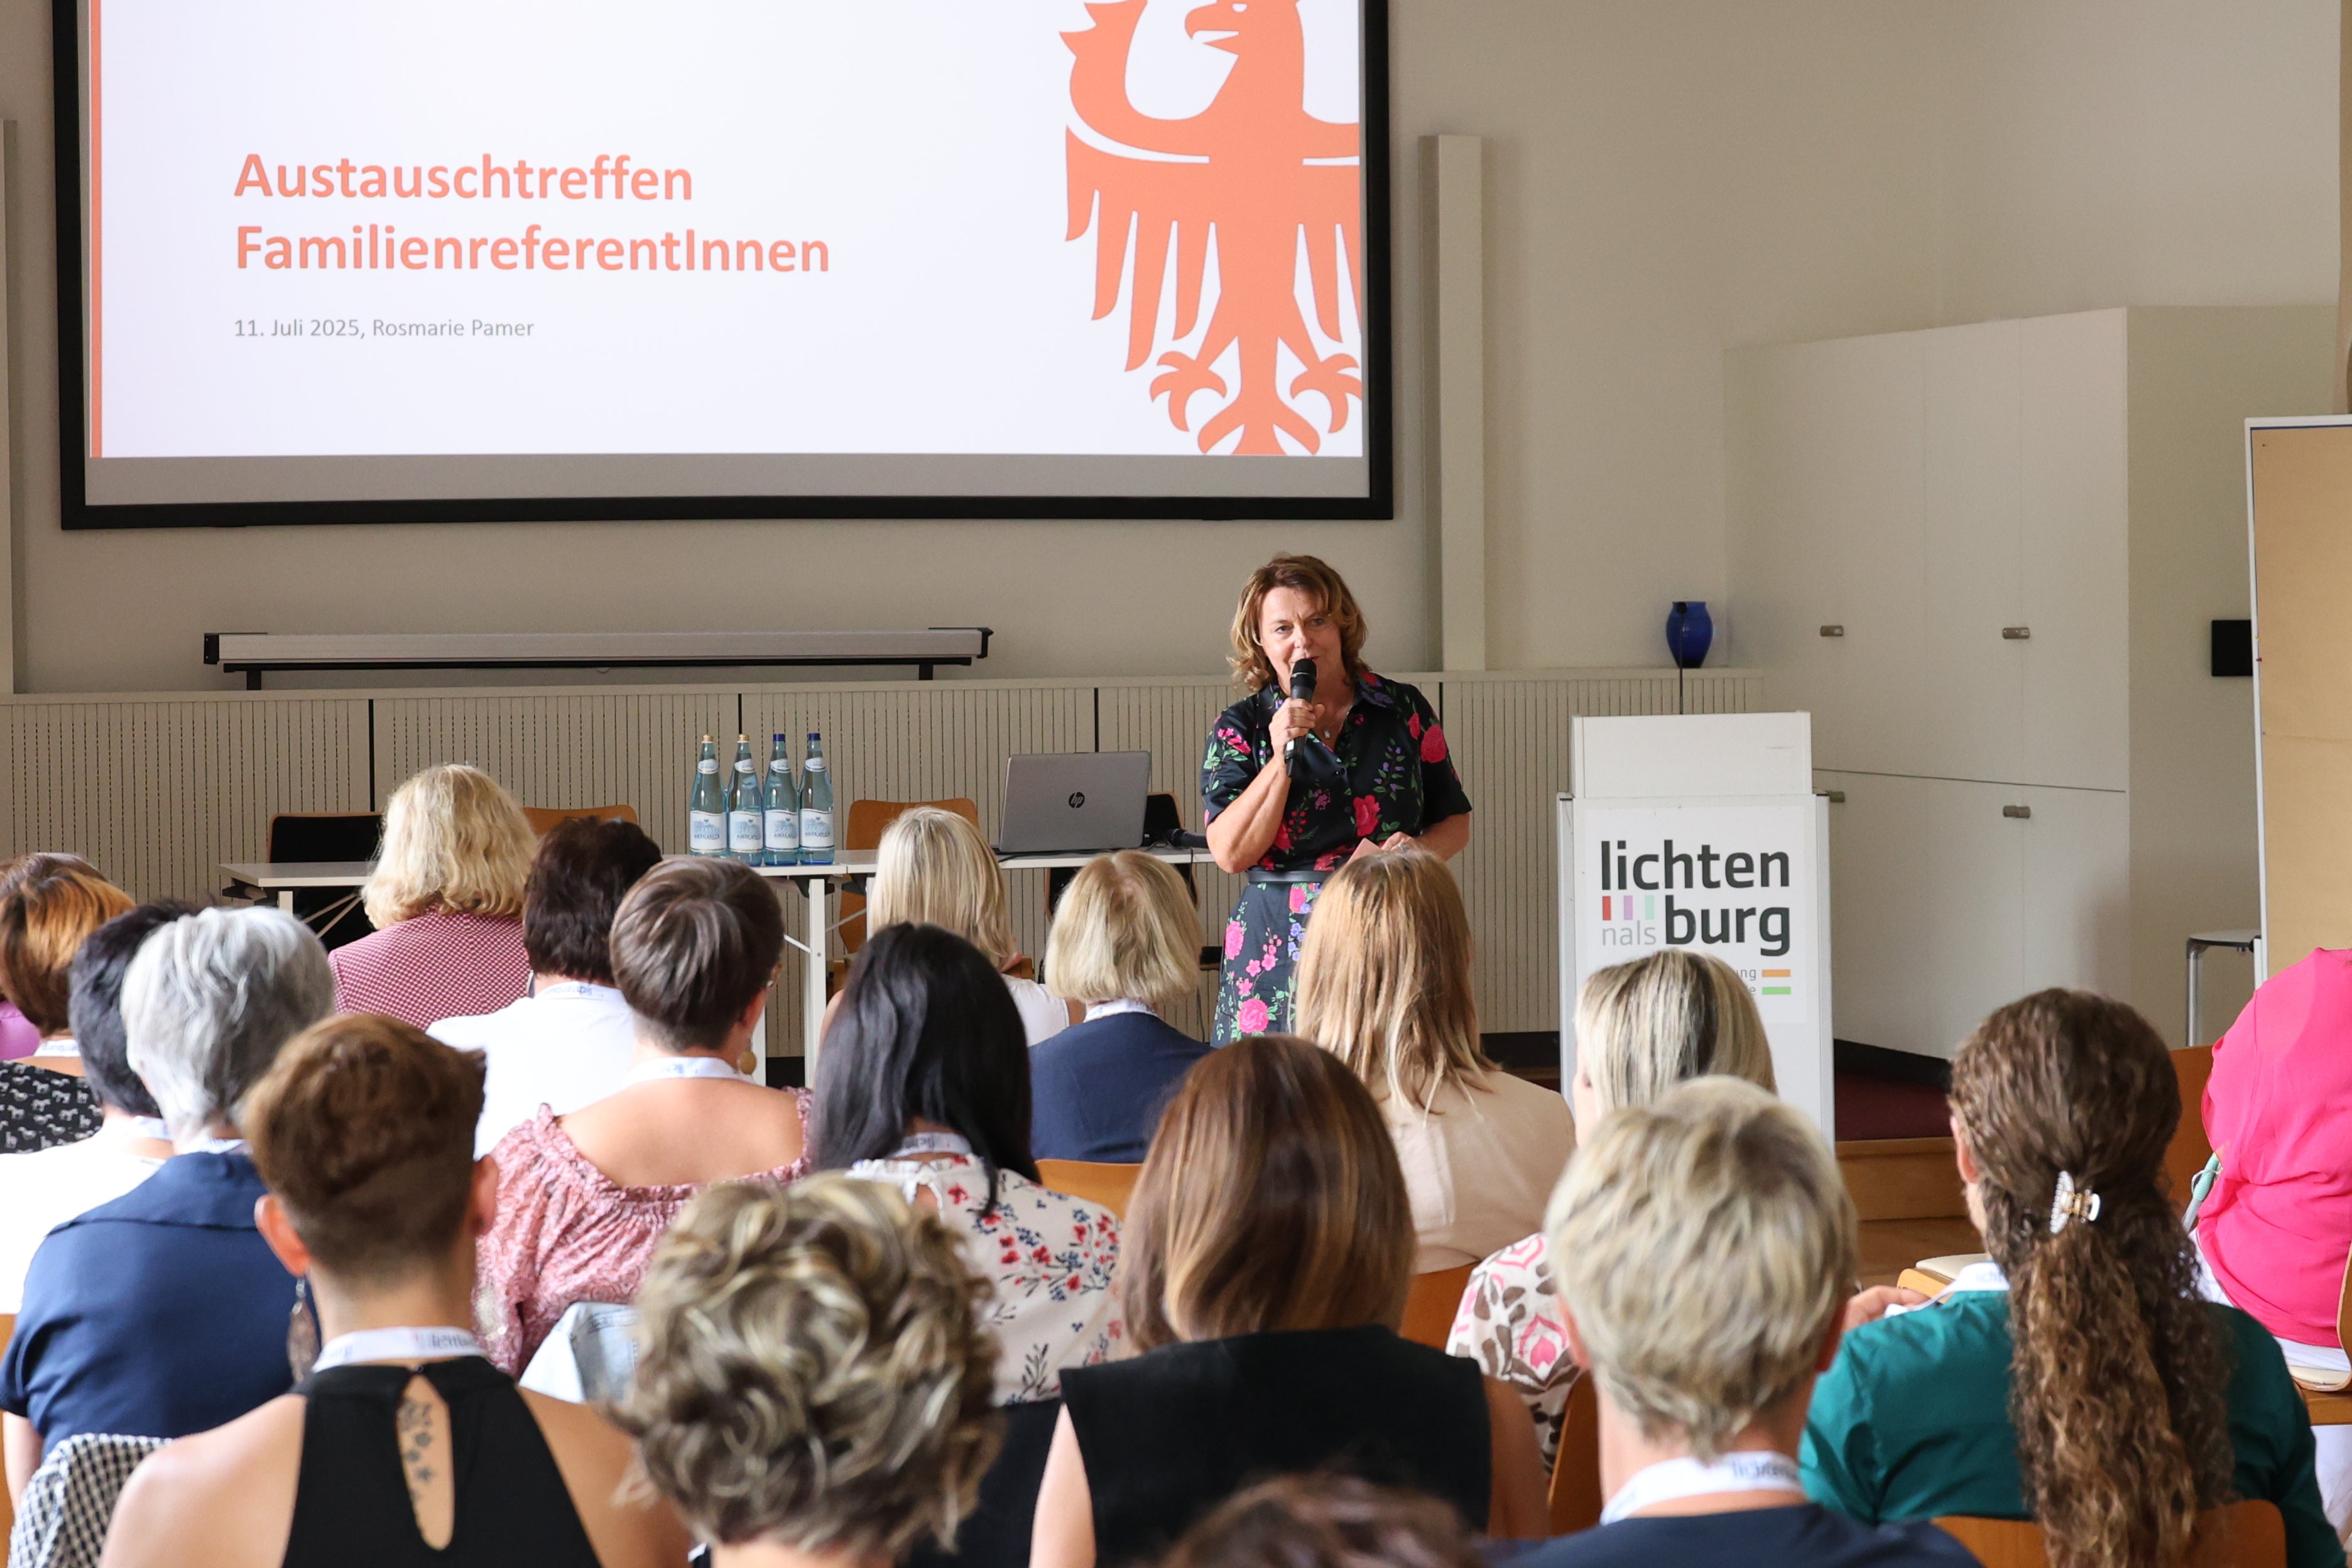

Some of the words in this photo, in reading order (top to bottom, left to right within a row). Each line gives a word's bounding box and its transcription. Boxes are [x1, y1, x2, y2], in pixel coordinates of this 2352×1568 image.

[234, 153, 692, 200] Austauschtreffen
[237, 224, 829, 272] FamilienreferentInnen
[235, 319, 264, 337] 11.
[271, 318, 303, 337] Juli
[310, 319, 366, 340] 2025,
[373, 319, 464, 337] Rosmarie
[472, 319, 535, 337] Pamer
[1070, 792, 1084, 808] hp
[1601, 839, 1790, 891] lichten
[1602, 920, 1657, 946] nals
[1664, 895, 1791, 957] burg
